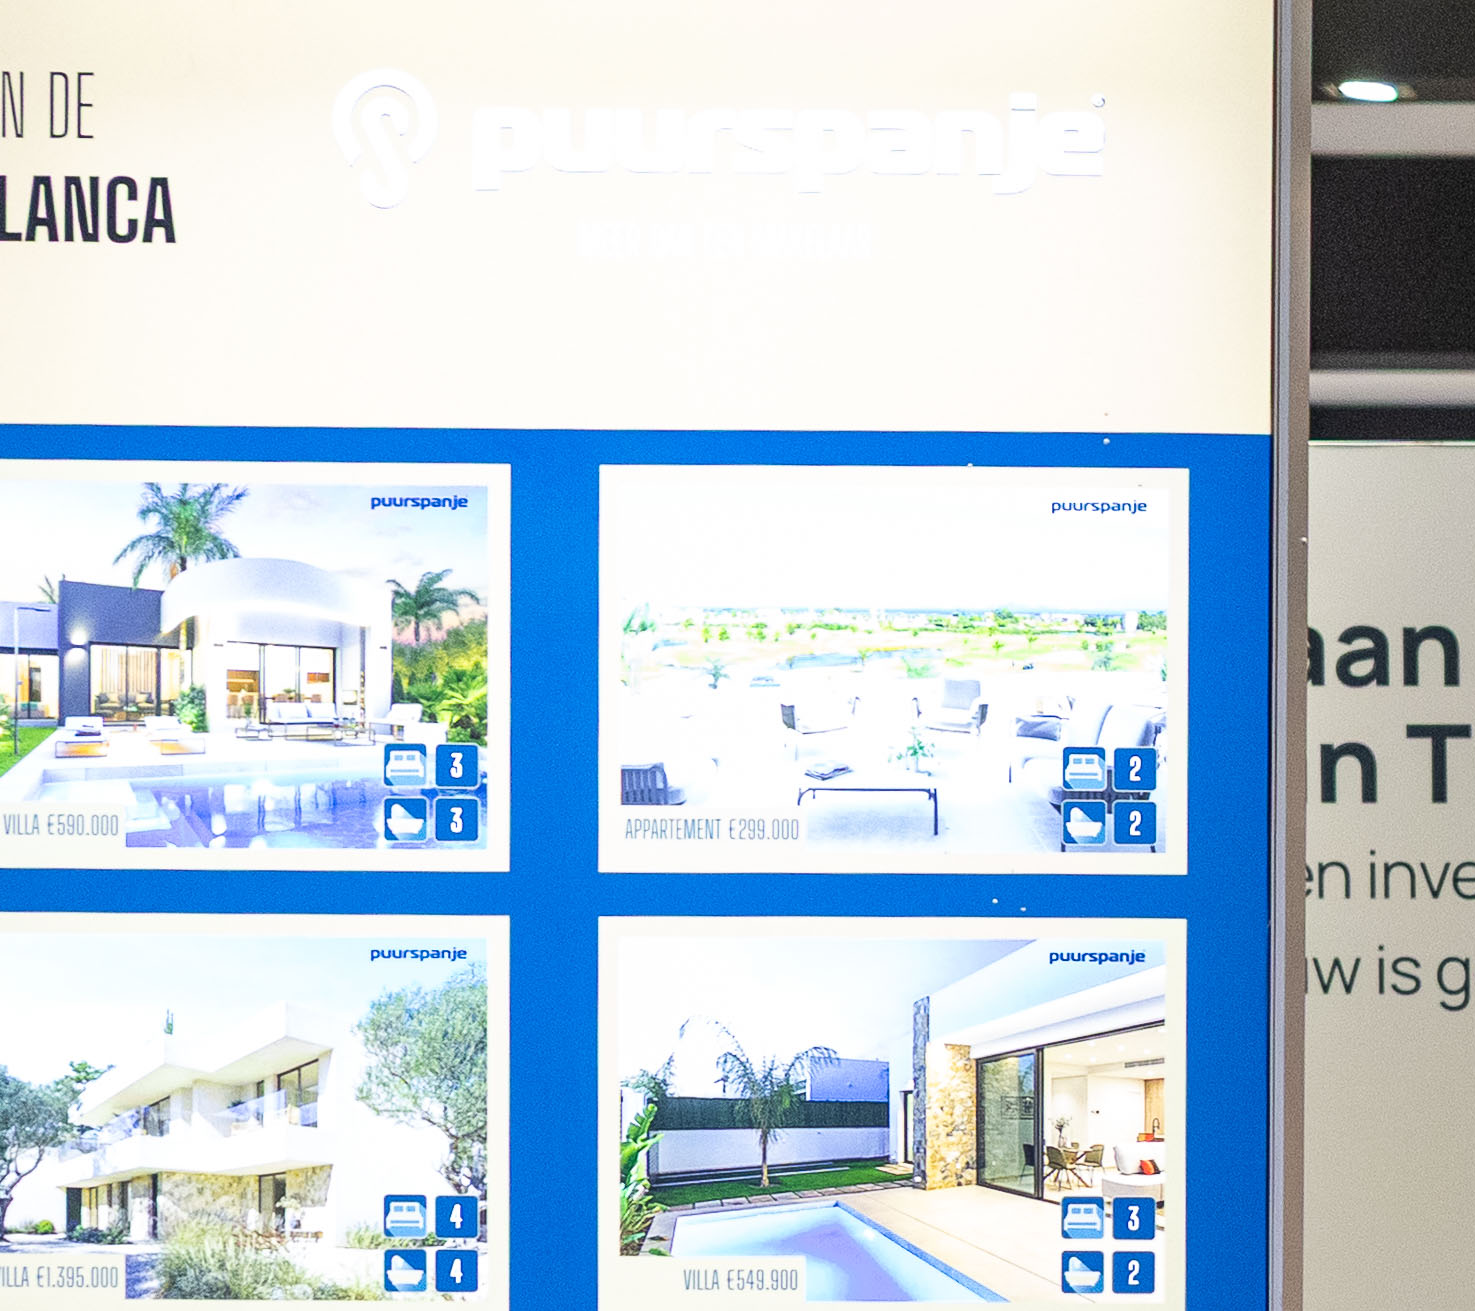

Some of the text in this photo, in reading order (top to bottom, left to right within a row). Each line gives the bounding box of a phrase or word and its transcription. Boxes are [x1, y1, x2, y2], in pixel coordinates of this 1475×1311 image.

[49, 71, 95, 139] DE
[472, 92, 1105, 195] puurspanje
[0, 175, 177, 244] LANCA
[370, 494, 469, 512] puurspanje
[1050, 499, 1149, 515] puurspanje
[450, 752, 464, 779] 3
[1129, 755, 1143, 781] 2
[3, 812, 119, 837] VILLA €590.000
[450, 807, 464, 834] 3
[625, 817, 800, 841] APPARTEMENT €299.000
[1129, 811, 1143, 837] 2
[1305, 860, 1351, 900] n
[370, 945, 468, 962] puurspanje
[1048, 949, 1147, 966] puurspanje
[1305, 956, 1362, 996] w
[1376, 944, 1422, 996] is
[450, 1203, 464, 1229] 4
[1128, 1205, 1141, 1232] 3
[37, 1266, 119, 1288] €1.395.000
[450, 1257, 464, 1284] 4
[683, 1268, 799, 1292] VILLA €549.900
[1128, 1260, 1141, 1286] 2
